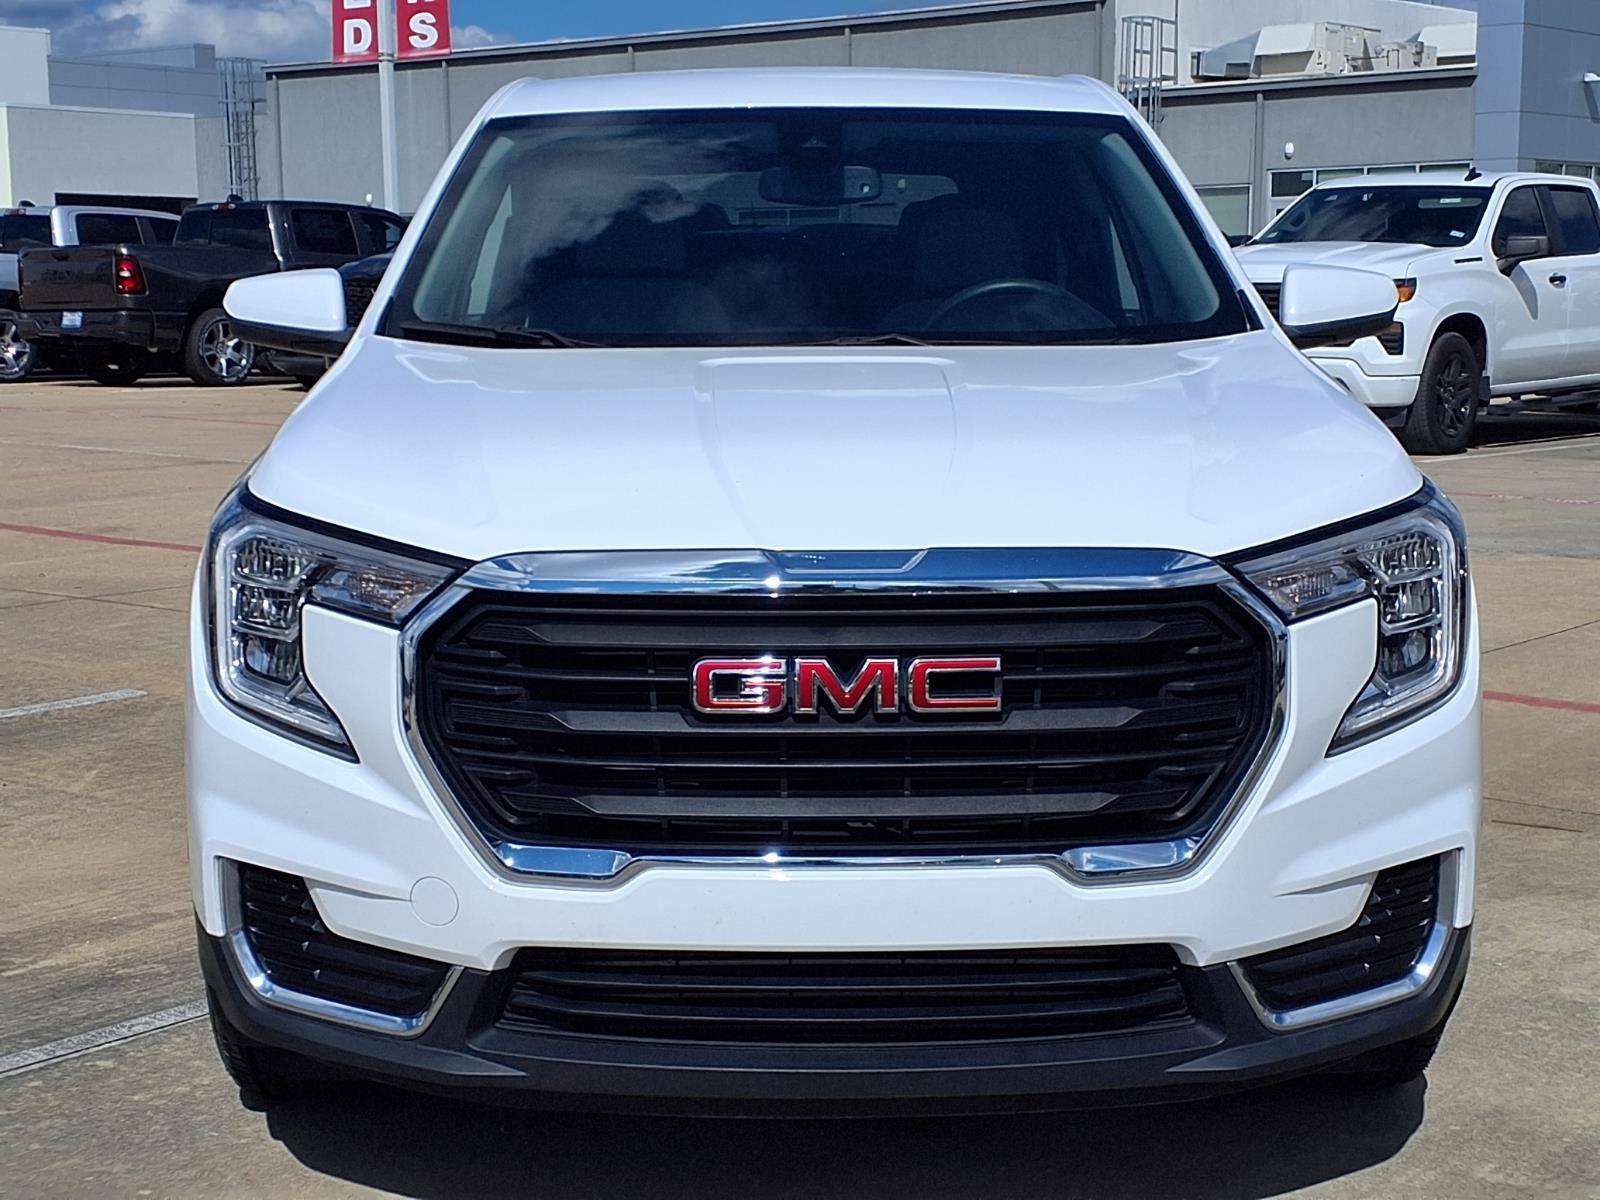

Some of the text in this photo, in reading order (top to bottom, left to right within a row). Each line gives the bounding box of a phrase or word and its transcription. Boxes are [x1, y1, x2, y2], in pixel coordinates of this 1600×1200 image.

[343, 0, 372, 54] D
[407, 0, 439, 48] S
[692, 656, 1001, 714] GMC
